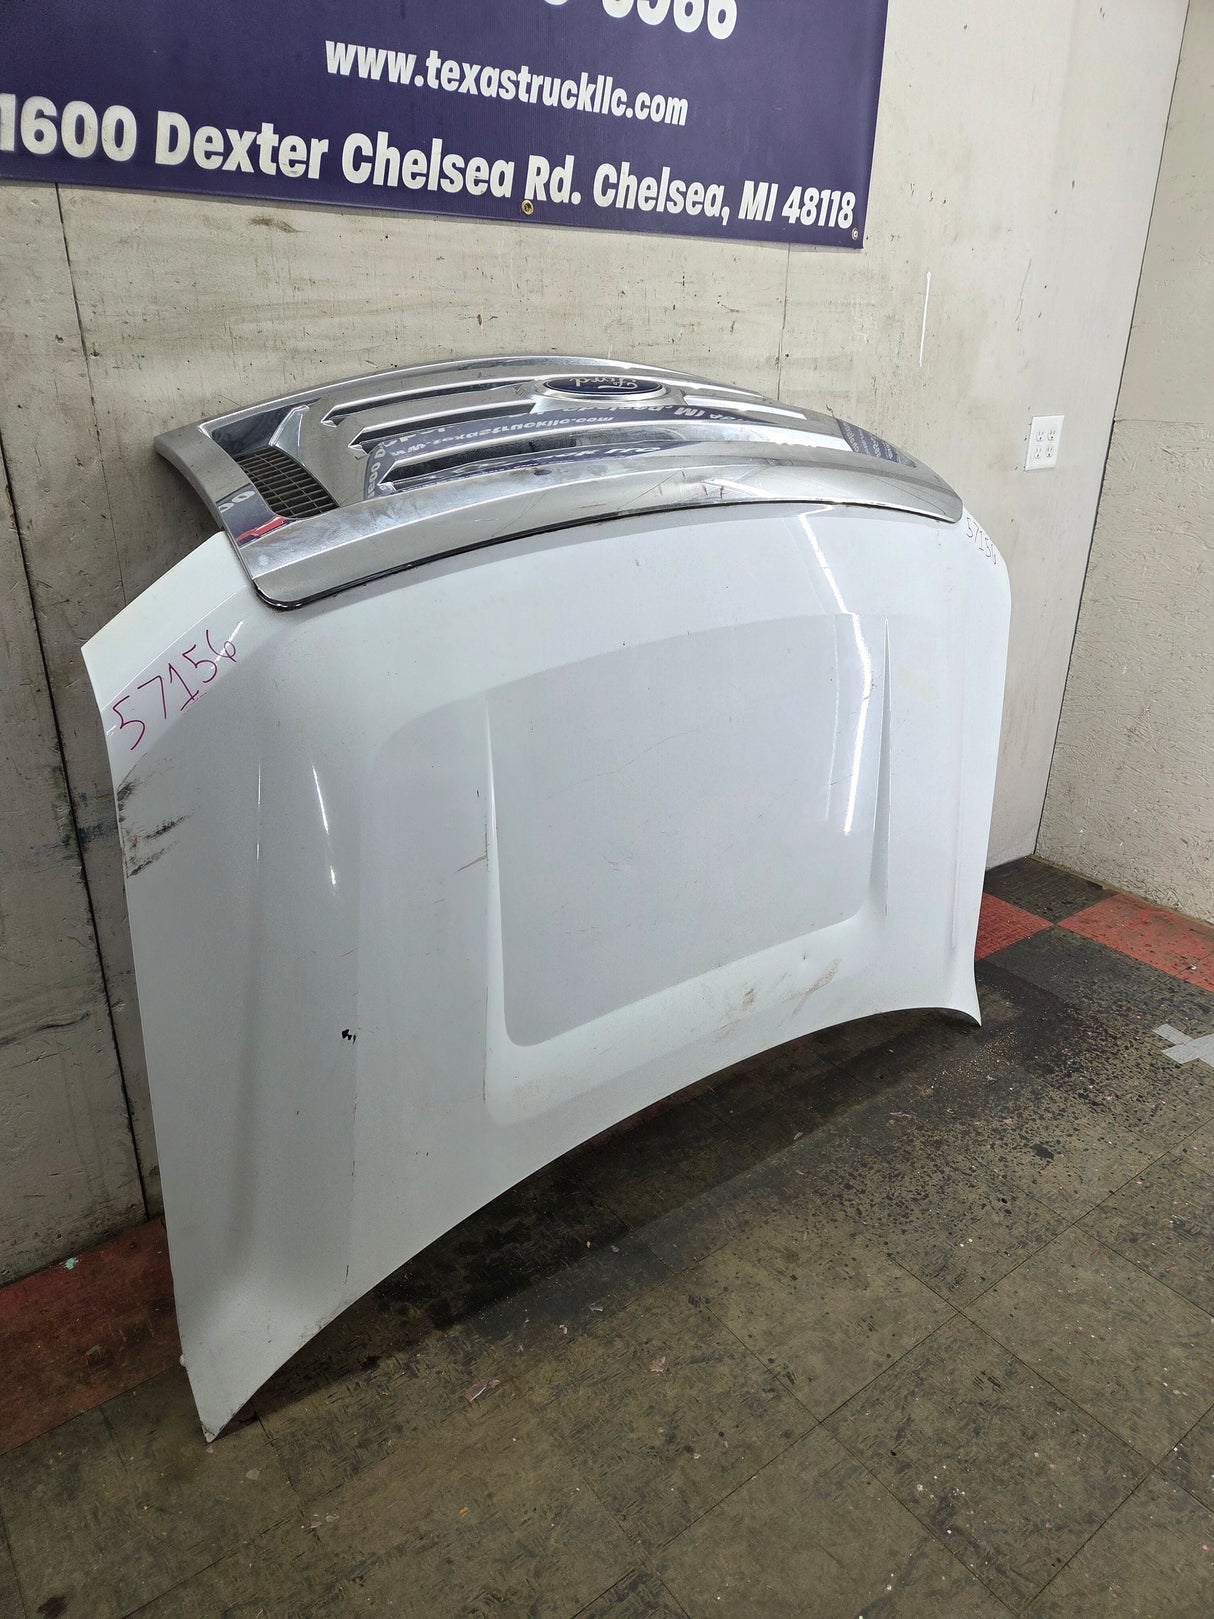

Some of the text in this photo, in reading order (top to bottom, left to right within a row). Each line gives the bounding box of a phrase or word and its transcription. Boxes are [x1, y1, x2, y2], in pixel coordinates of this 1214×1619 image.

[325, 40, 689, 127] www.texastruckllc.com
[155, 110, 329, 180] Dexter
[341, 132, 515, 198] Chelsea
[524, 154, 582, 205] Rd.
[592, 162, 731, 226] Chelsea,
[737, 180, 779, 222] MI
[781, 185, 857, 230] 48118
[112, 629, 237, 751] 57156
